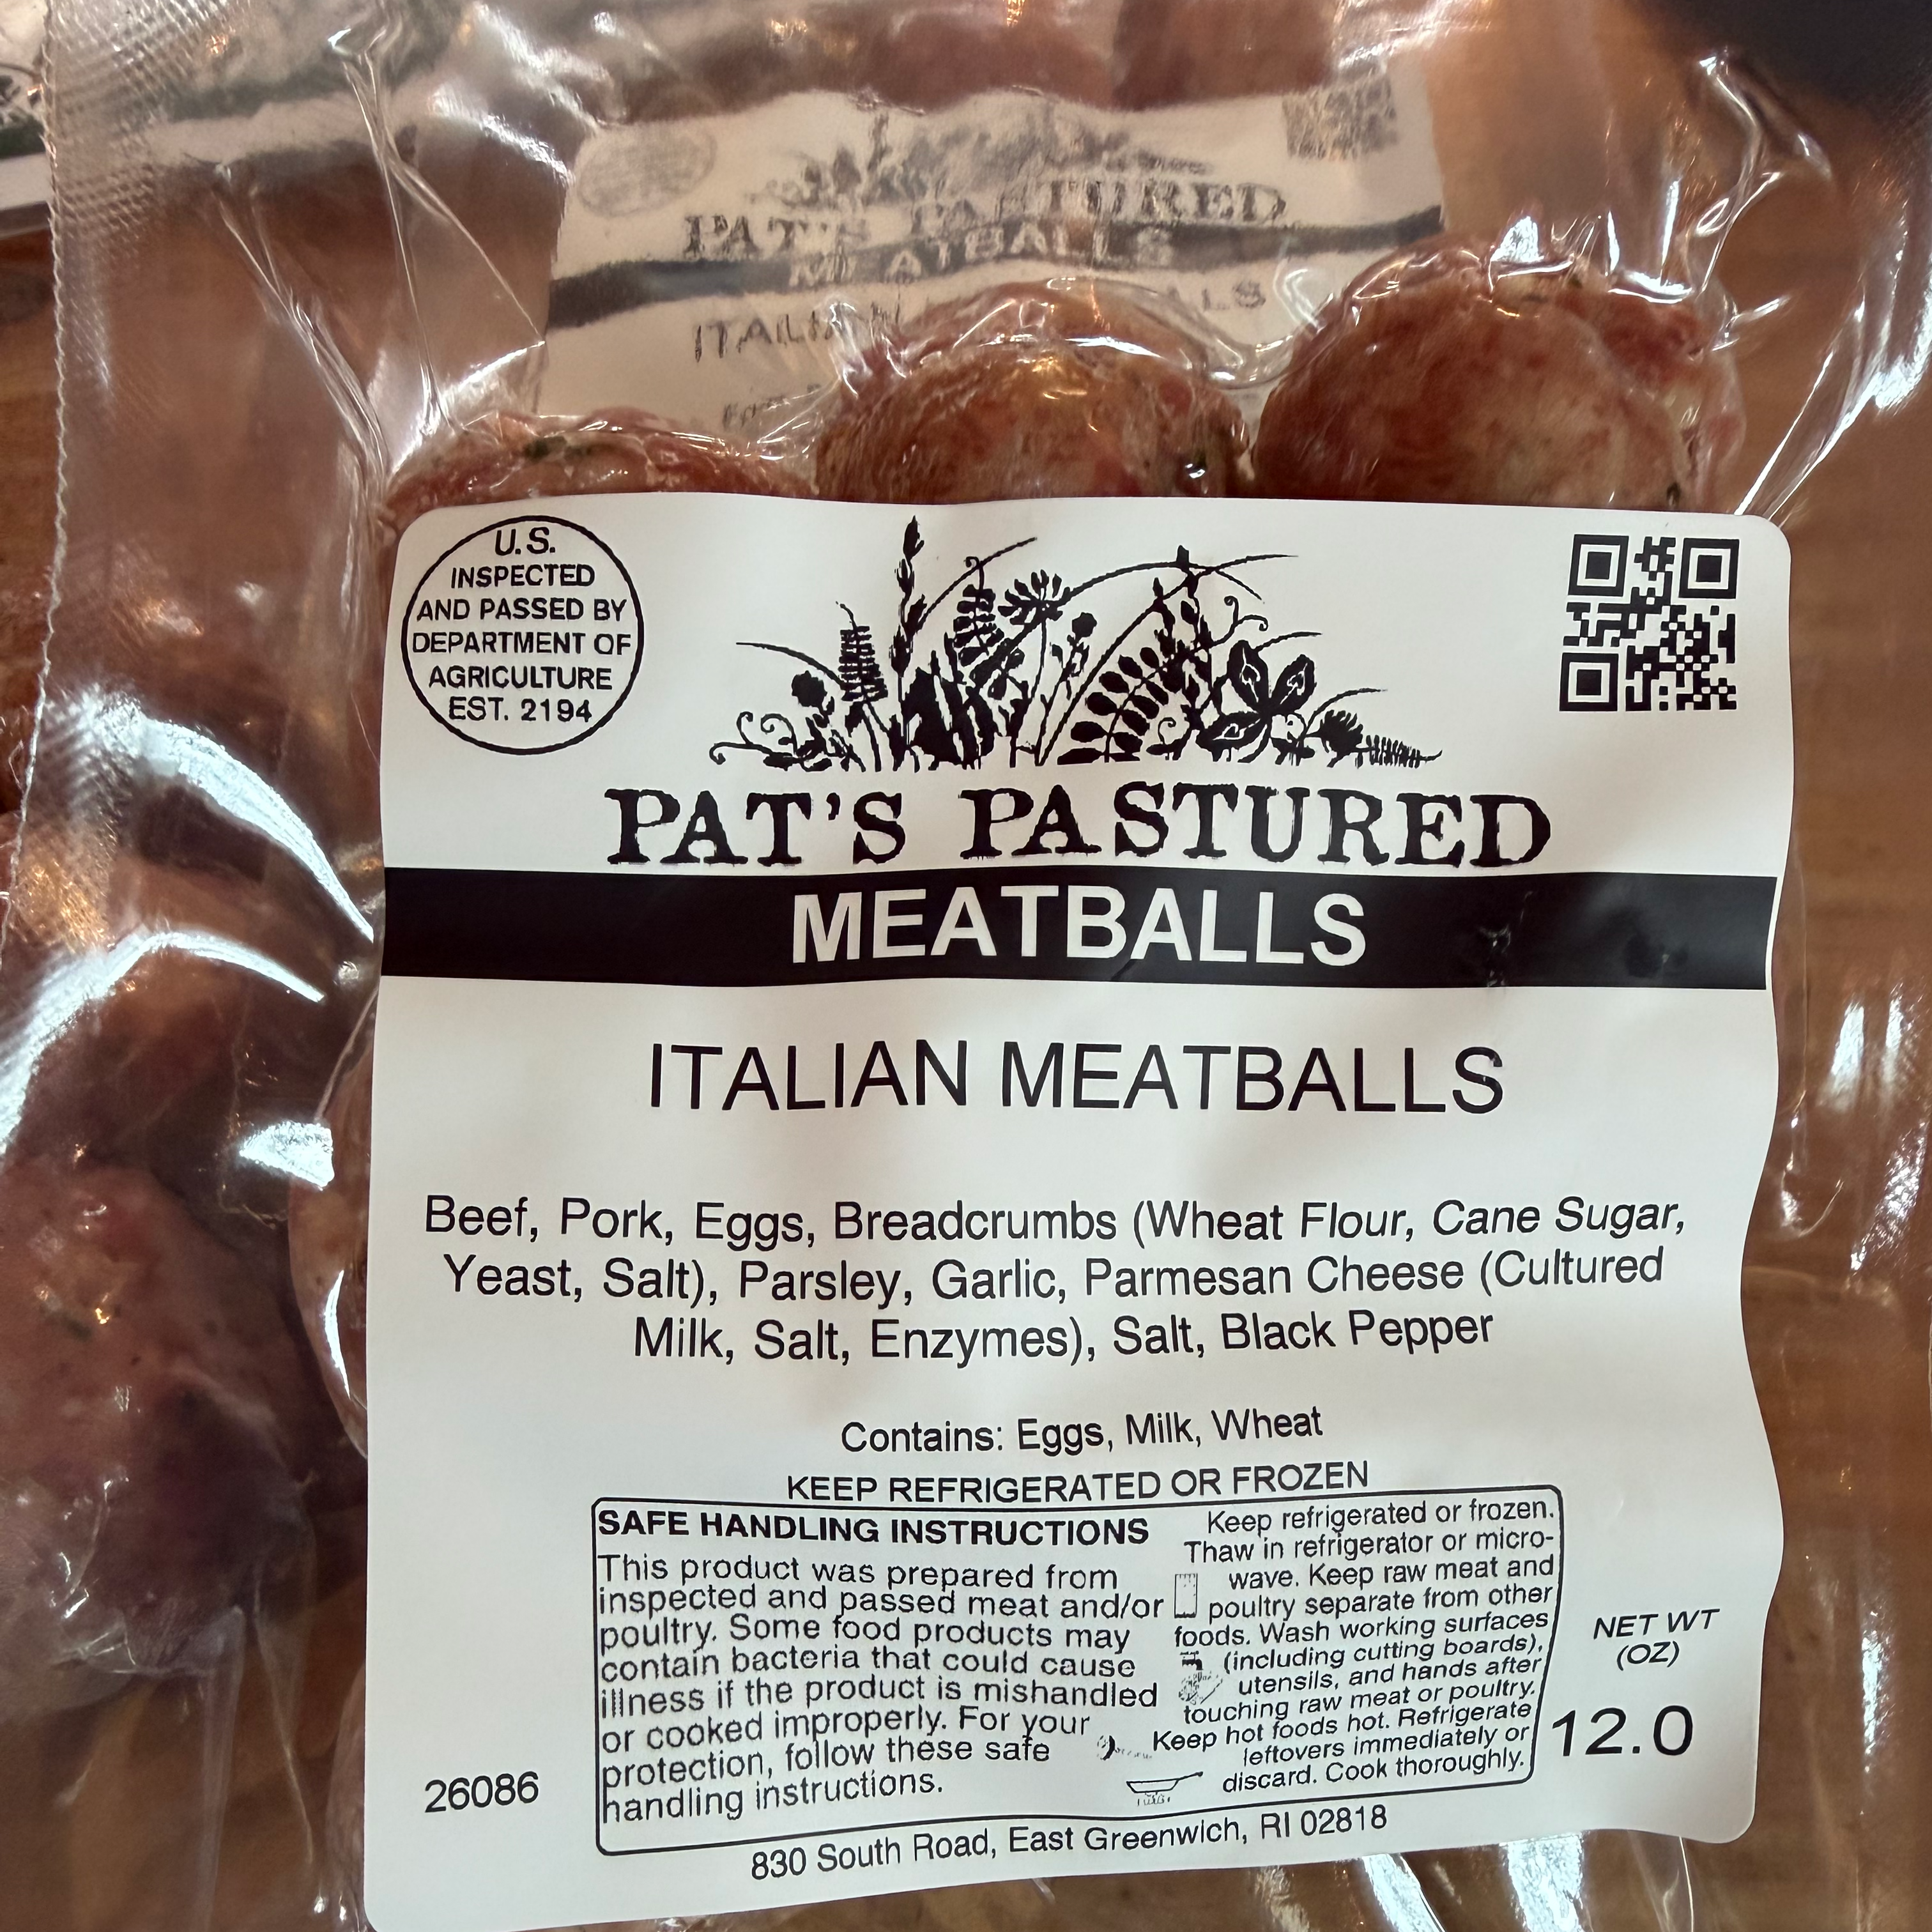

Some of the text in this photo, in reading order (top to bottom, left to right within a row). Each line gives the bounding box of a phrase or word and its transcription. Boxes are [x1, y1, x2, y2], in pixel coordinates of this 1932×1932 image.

[495, 527, 555, 556] U.S.
[451, 564, 595, 588] INSPECTED
[417, 597, 627, 622] AND PASSED BY
[413, 632, 631, 655] DEPARTMENT OF
[429, 665, 612, 690] AGRICULTURE
[449, 696, 592, 723] EST. 2194
[604, 781, 1551, 867] PAT'S PASTURED
[793, 885, 1365, 966] MEATBALLS
[651, 1039, 1503, 1114] ITALIAN MEATBALLS
[426, 1195, 1683, 1252] Beef, Pork, Eggs, Breadcrumbs (Wheat Flour, Cane Sugar,
[443, 1246, 1664, 1310] Yeast, Salt), Parsley, Garlic, Parmesan Cheese (Cultured
[635, 1310, 1493, 1368] Milk, Salt, Enzymes), Salt, Black Pepper
[842, 1406, 1322, 1457] Contains: Eggs, Milk, Wheat
[788, 1460, 1367, 1503] KEEP REFRIGERATED OR FROZEN
[599, 1510, 1149, 1545] SAFE HANDLING INSTRUCTIONS
[1209, 1498, 1553, 1538] Keep refrigerated or frozen.
[1184, 1527, 1553, 1563] Thaw in refrigerator or micro-
[597, 1553, 1117, 1592] This product was prepared from
[1229, 1554, 1553, 1590] wave. Keep raw meat and
[600, 1583, 1164, 1620] inspected and passed meat and/or
[1209, 1583, 1552, 1625] poultry separate from other
[601, 1613, 1130, 1657] poultry. Some food products may
[1174, 1611, 1548, 1647] foods. Wash working surfaces
[1593, 1609, 1720, 1639] NET WT
[602, 1645, 1135, 1683] contain bacteria that could cause
[1224, 1633, 1542, 1675] (including cutting boards),
[1617, 1641, 1679, 1671] (OZ)
[602, 1673, 1157, 1719] illness if the product is mishandled
[1239, 1656, 1542, 1695] utensils, and hands after
[1184, 1680, 1535, 1724] touching raw meat or poultry.
[602, 1704, 1091, 1753] or cooked improperly. For your
[1154, 1701, 1531, 1752] Keep hot foods hot. Refrigerate
[1244, 1725, 1529, 1767] leftovers immediately or
[1552, 1705, 1692, 1756] 12.0
[601, 1735, 1049, 1792] protection, follow these safe
[1223, 1747, 1524, 1793] discard. Cook thoroughly.
[425, 1771, 539, 1813] 26086
[602, 1771, 942, 1823] handling instructions.
[752, 1804, 1386, 1880] 830 South Road, East Greenwich, RI 02818
